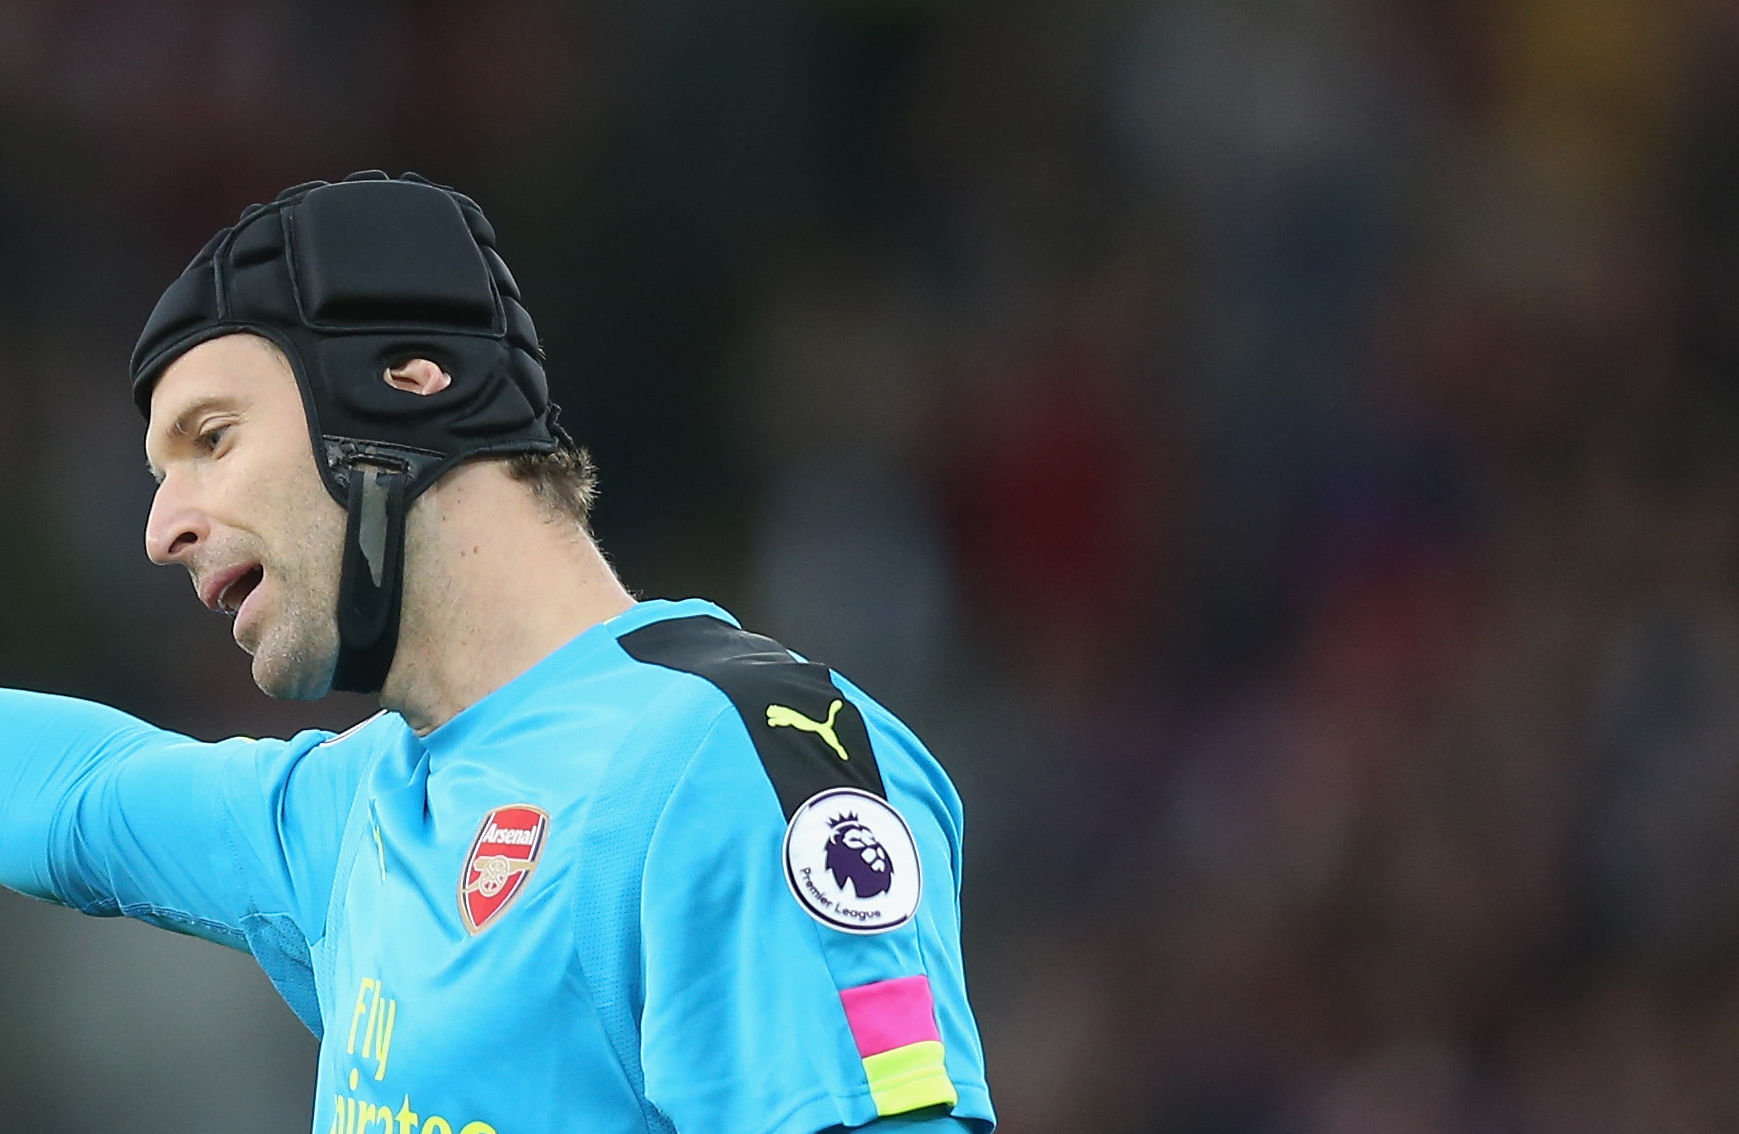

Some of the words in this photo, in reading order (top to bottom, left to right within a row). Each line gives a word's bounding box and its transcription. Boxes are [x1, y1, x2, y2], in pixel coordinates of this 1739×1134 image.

[482, 822, 537, 845] Arsenal
[800, 866, 833, 908] Premier
[834, 903, 882, 921] League
[347, 976, 397, 1081] Fly
